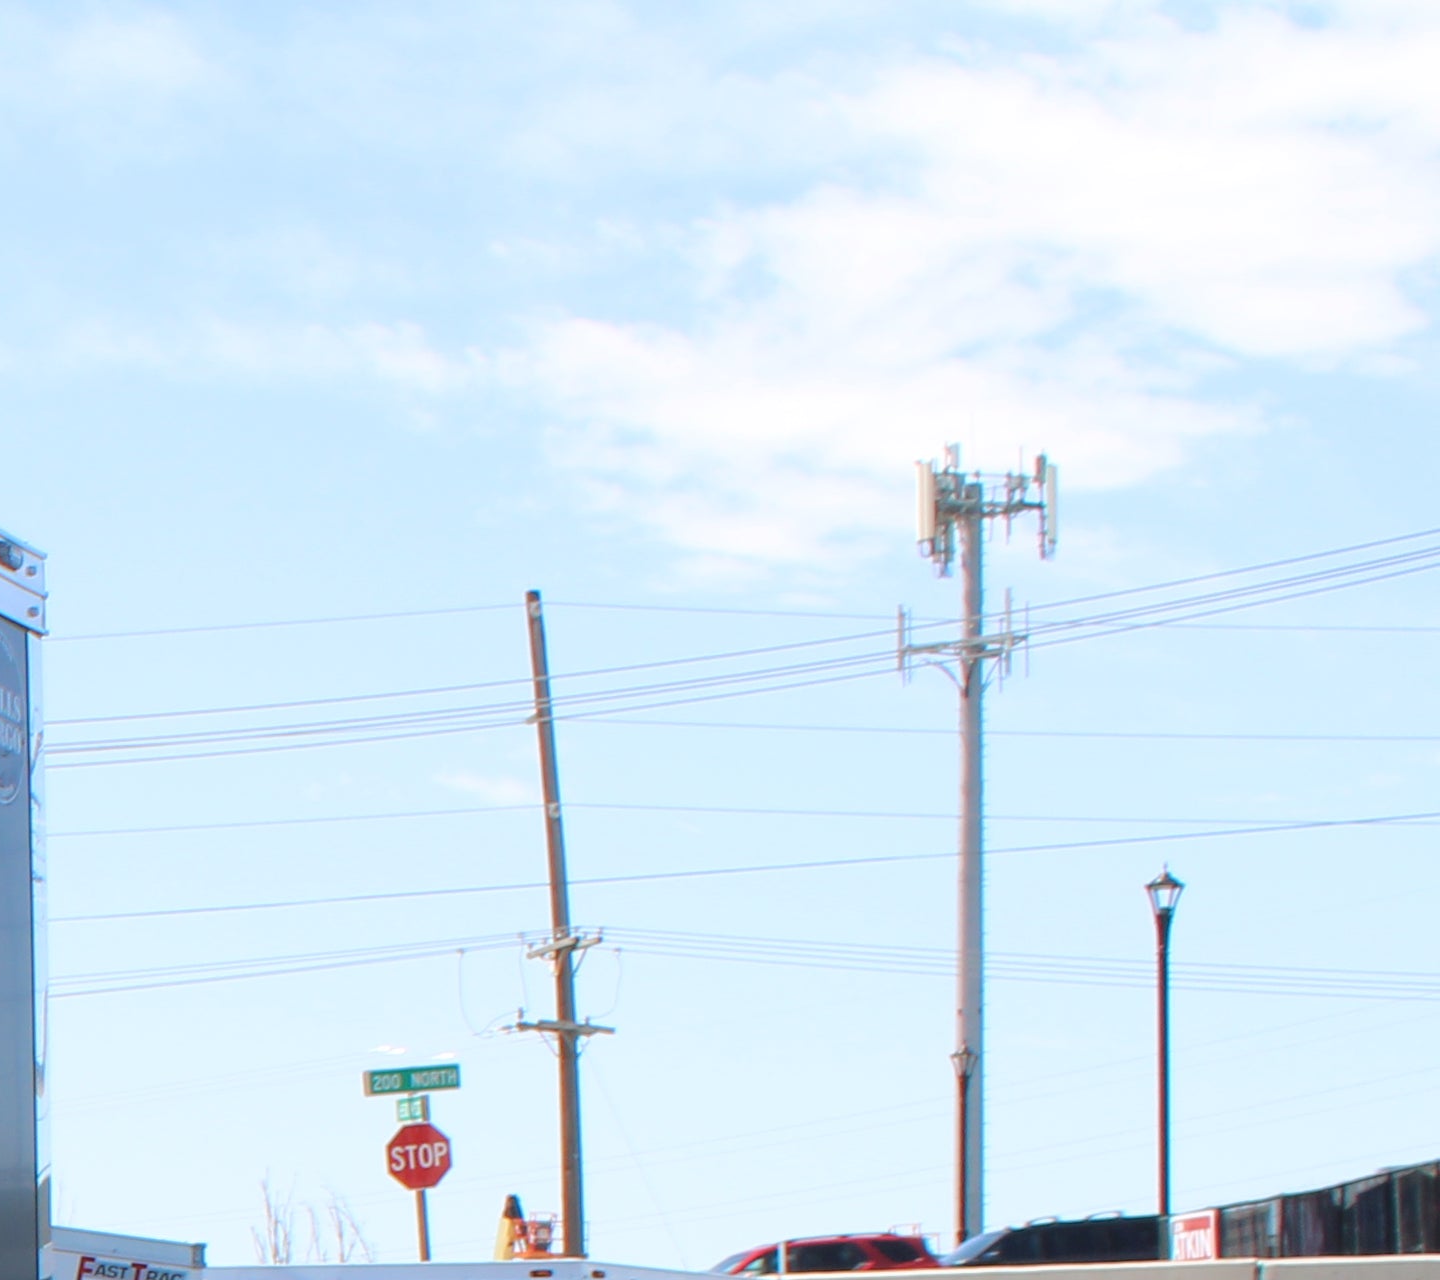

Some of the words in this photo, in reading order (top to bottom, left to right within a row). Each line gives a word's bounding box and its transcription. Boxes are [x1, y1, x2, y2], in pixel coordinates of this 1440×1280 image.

[372, 1074, 401, 1092] 200
[411, 1069, 457, 1088] NORTH
[391, 1142, 448, 1171] STOP
